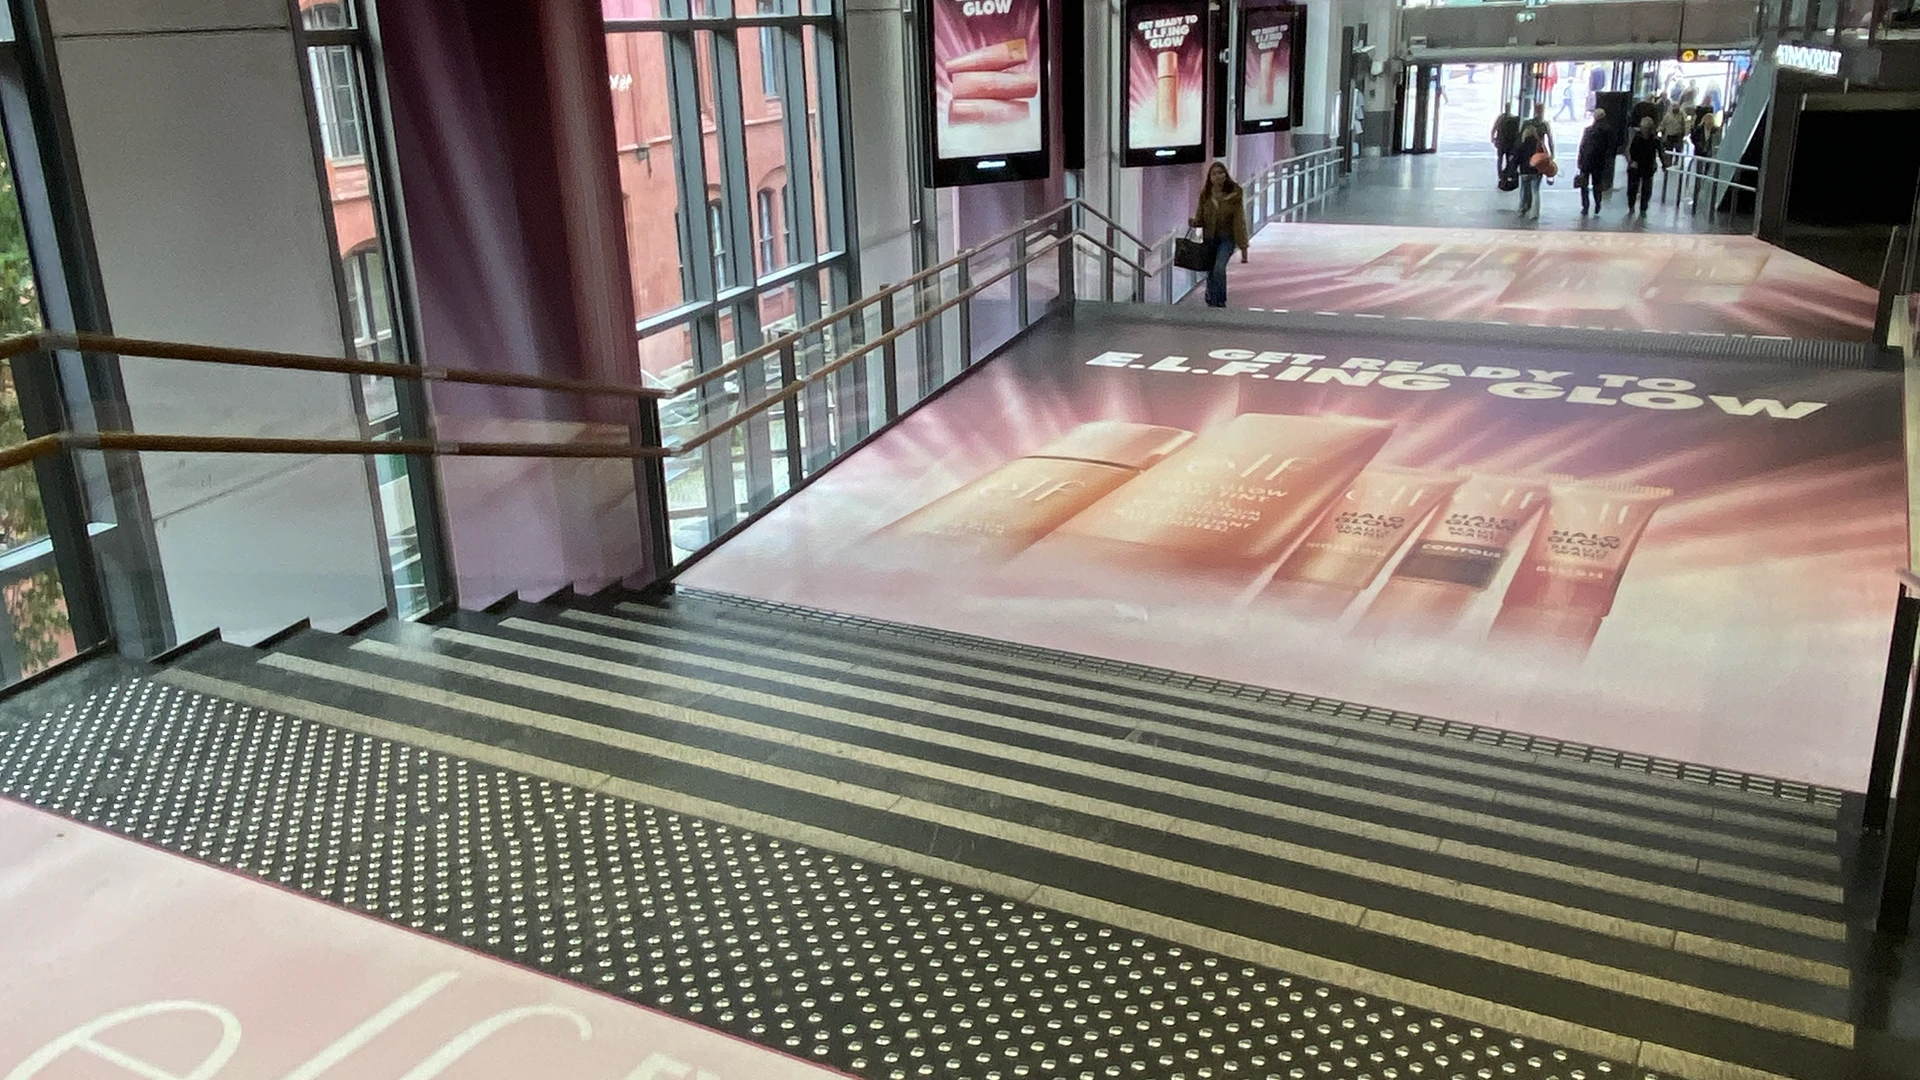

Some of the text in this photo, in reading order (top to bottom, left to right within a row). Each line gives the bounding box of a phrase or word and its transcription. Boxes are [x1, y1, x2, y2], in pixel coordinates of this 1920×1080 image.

[963, 0, 1012, 16] GLOW
[1185, 14, 1199, 24] TO
[1150, 35, 1184, 48] GLOW
[1208, 348, 1696, 392] GET READY TO
[1085, 350, 1828, 419] E.L.F.ING GLOW
[1552, 529, 1621, 542] HALO
